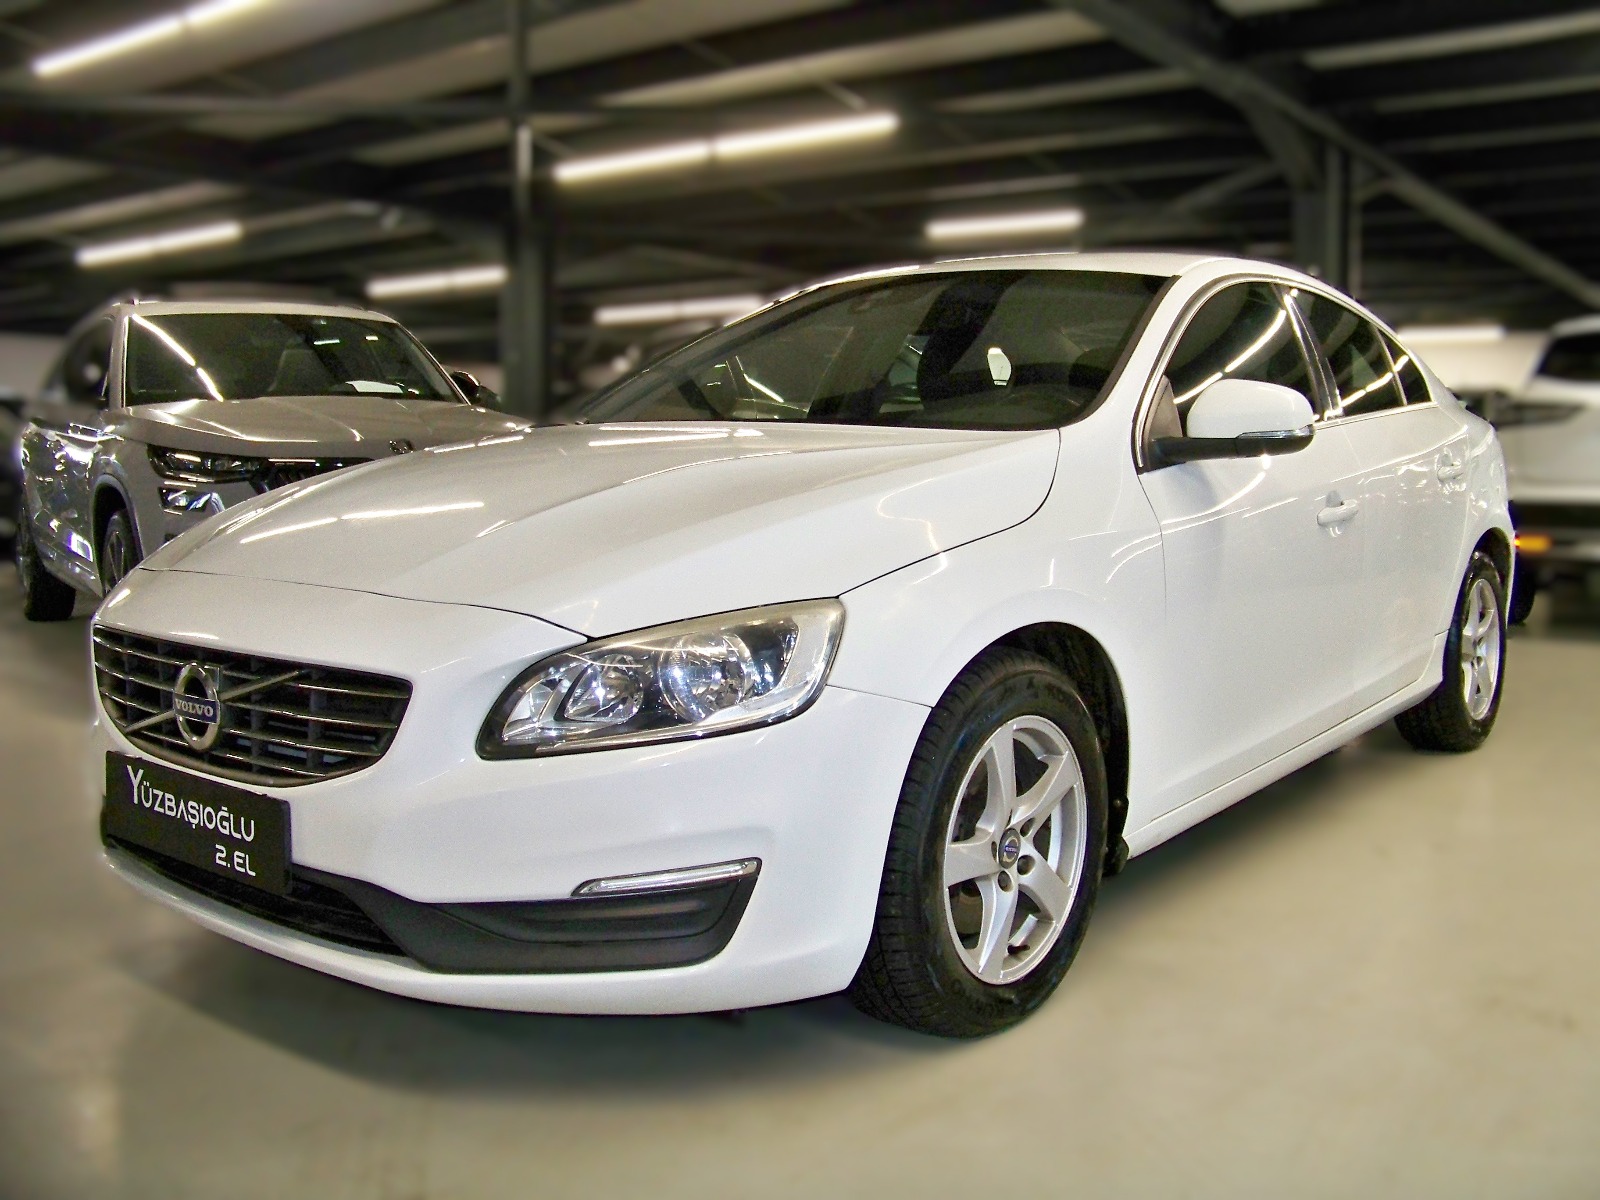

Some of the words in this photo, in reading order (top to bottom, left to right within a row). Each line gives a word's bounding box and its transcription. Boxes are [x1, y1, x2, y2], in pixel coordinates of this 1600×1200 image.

[175, 699, 214, 718] VOLVO
[126, 764, 255, 842] YÜZBAŞIOĞLU
[233, 851, 256, 877] EL
